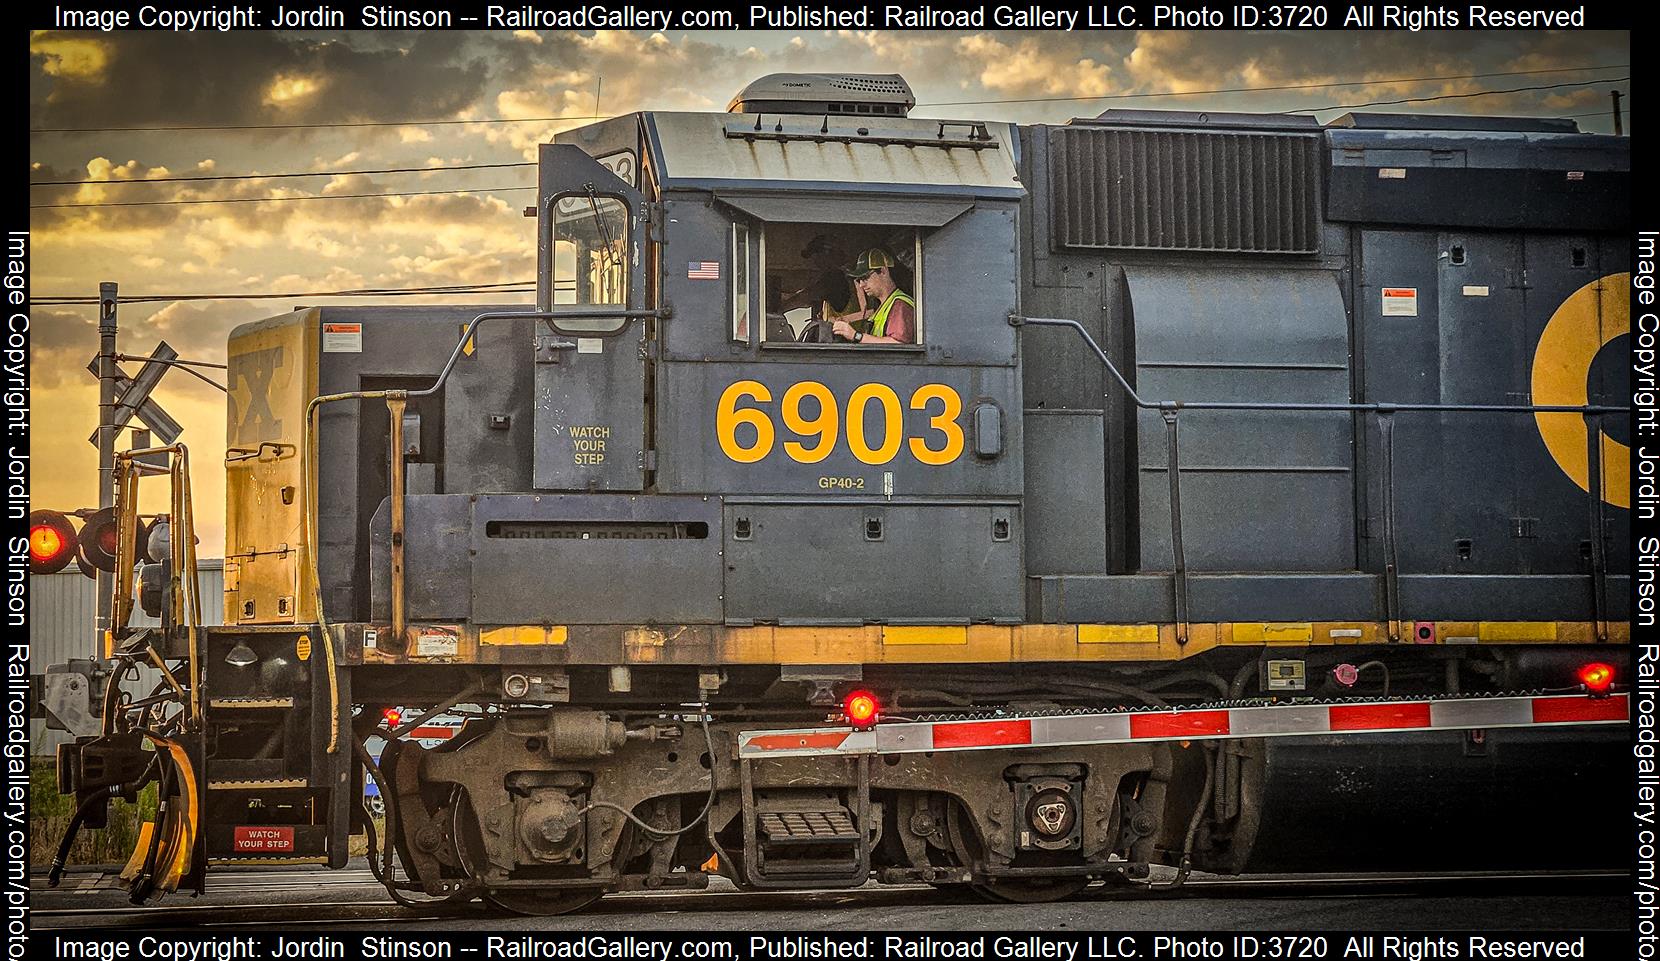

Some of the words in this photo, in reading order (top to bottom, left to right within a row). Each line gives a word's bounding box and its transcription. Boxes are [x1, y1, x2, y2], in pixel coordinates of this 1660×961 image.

[716, 379, 966, 466] 6903
[569, 426, 610, 438] WATCH
[573, 440, 605, 451] YOUR
[574, 453, 604, 465] STEP
[818, 477, 864, 489] GP40-2
[364, 631, 376, 647] F
[248, 831, 280, 839] WATCH
[238, 840, 263, 848] YOUR
[267, 840, 290, 848] STEP
